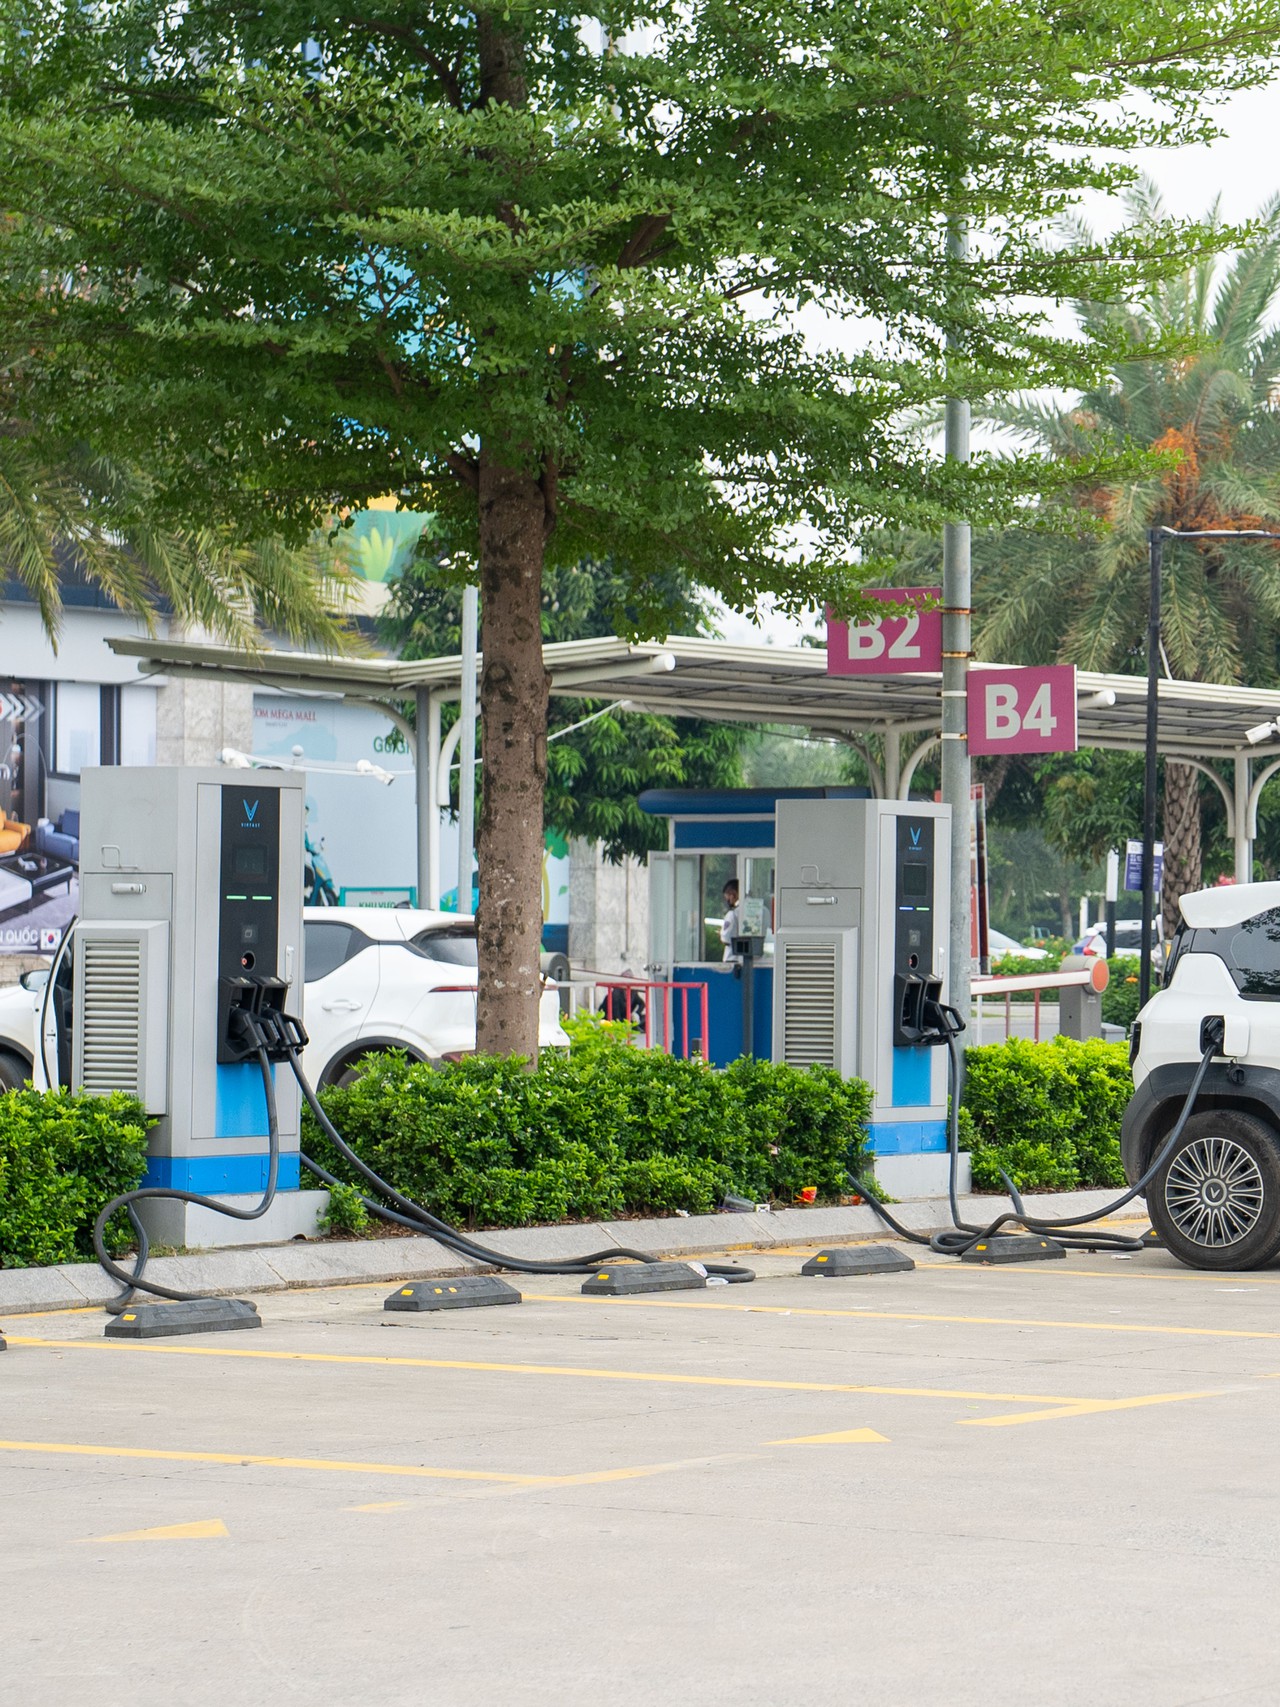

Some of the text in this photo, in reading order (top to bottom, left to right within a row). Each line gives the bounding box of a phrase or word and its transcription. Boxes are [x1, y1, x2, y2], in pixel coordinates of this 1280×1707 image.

[848, 610, 920, 660] B2
[271, 708, 294, 720] MEGA
[985, 683, 1057, 740] B4
[6, 925, 39, 944] QUỐC
